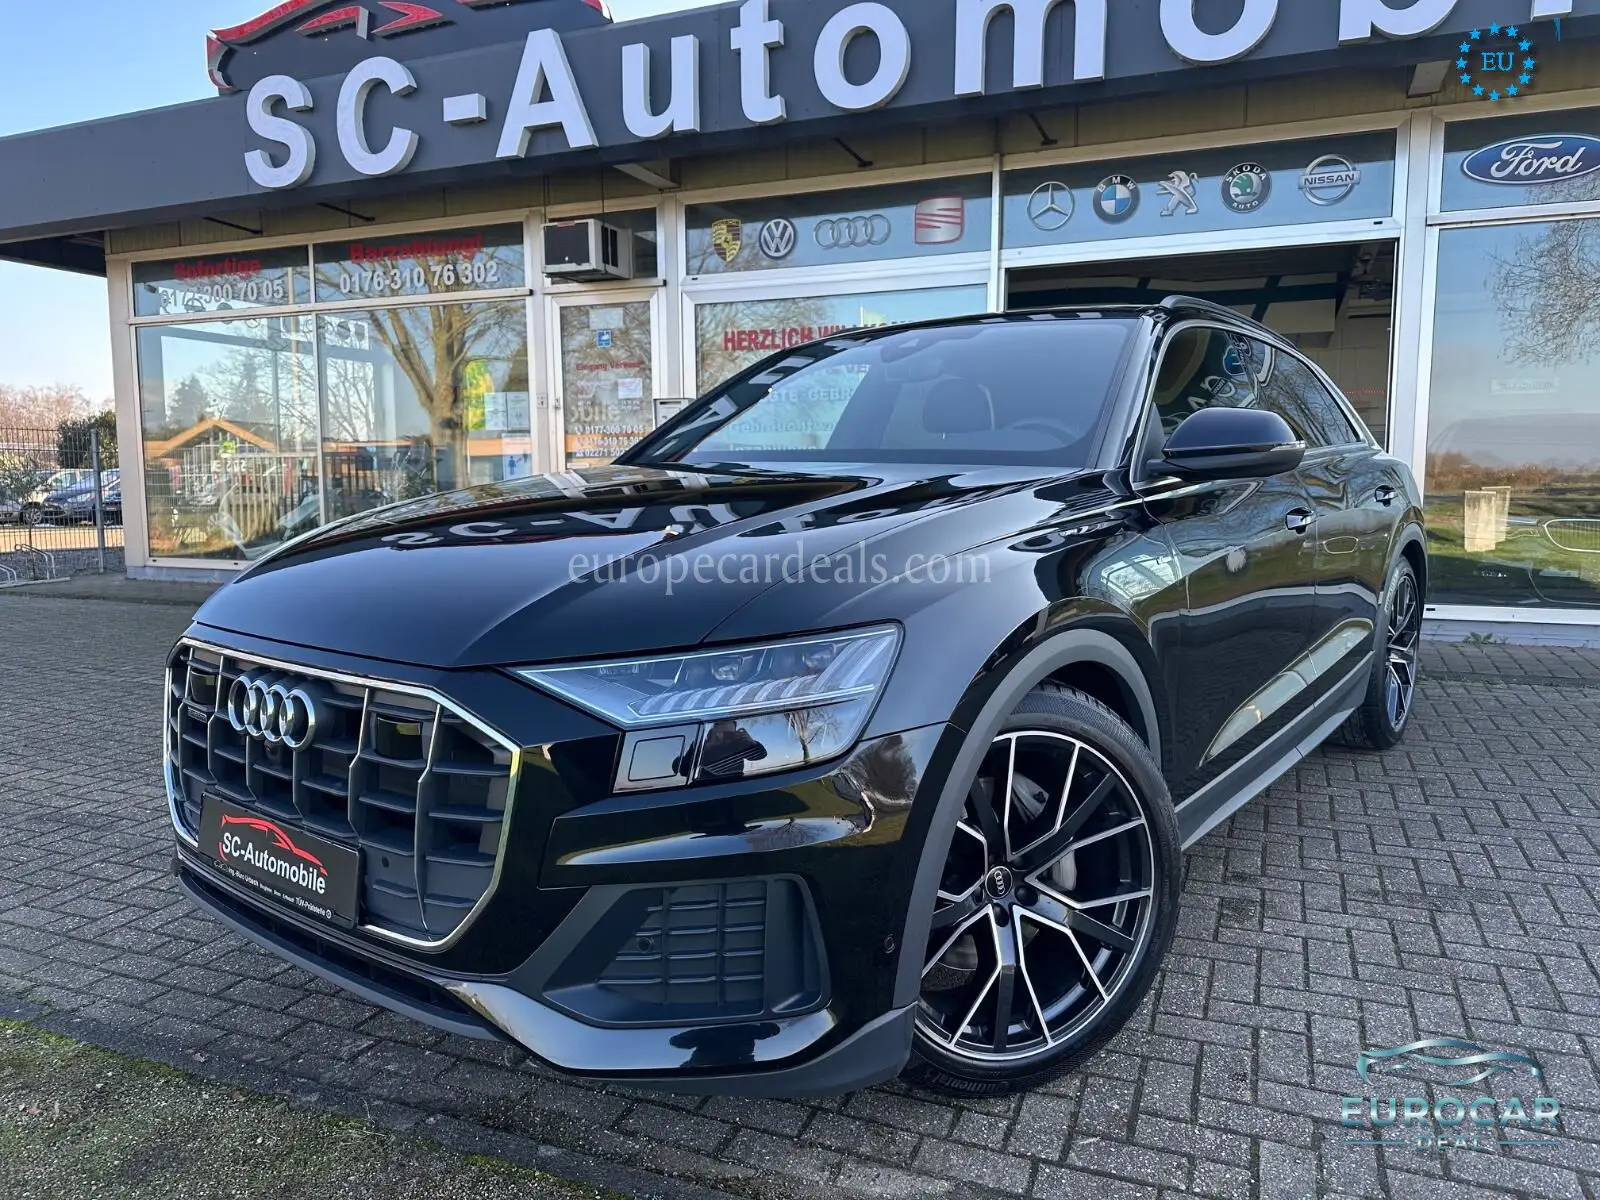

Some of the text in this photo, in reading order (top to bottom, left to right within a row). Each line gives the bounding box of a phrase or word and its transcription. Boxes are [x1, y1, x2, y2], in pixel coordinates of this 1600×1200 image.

[243, 0, 1572, 189] SC-Automo
[1490, 140, 1586, 178] Ford
[1098, 175, 1136, 193] BMW
[1303, 173, 1355, 187] NISSAN
[1231, 199, 1259, 211] AUTO
[348, 232, 485, 264] Barzahlung!
[173, 257, 262, 282] Sofortige
[340, 260, 499, 294] 0176-310 76 302
[237, 281, 258, 301] 70
[262, 279, 284, 299] 05
[722, 325, 814, 352] HERZLICH
[222, 831, 327, 895] SC-Automobile
